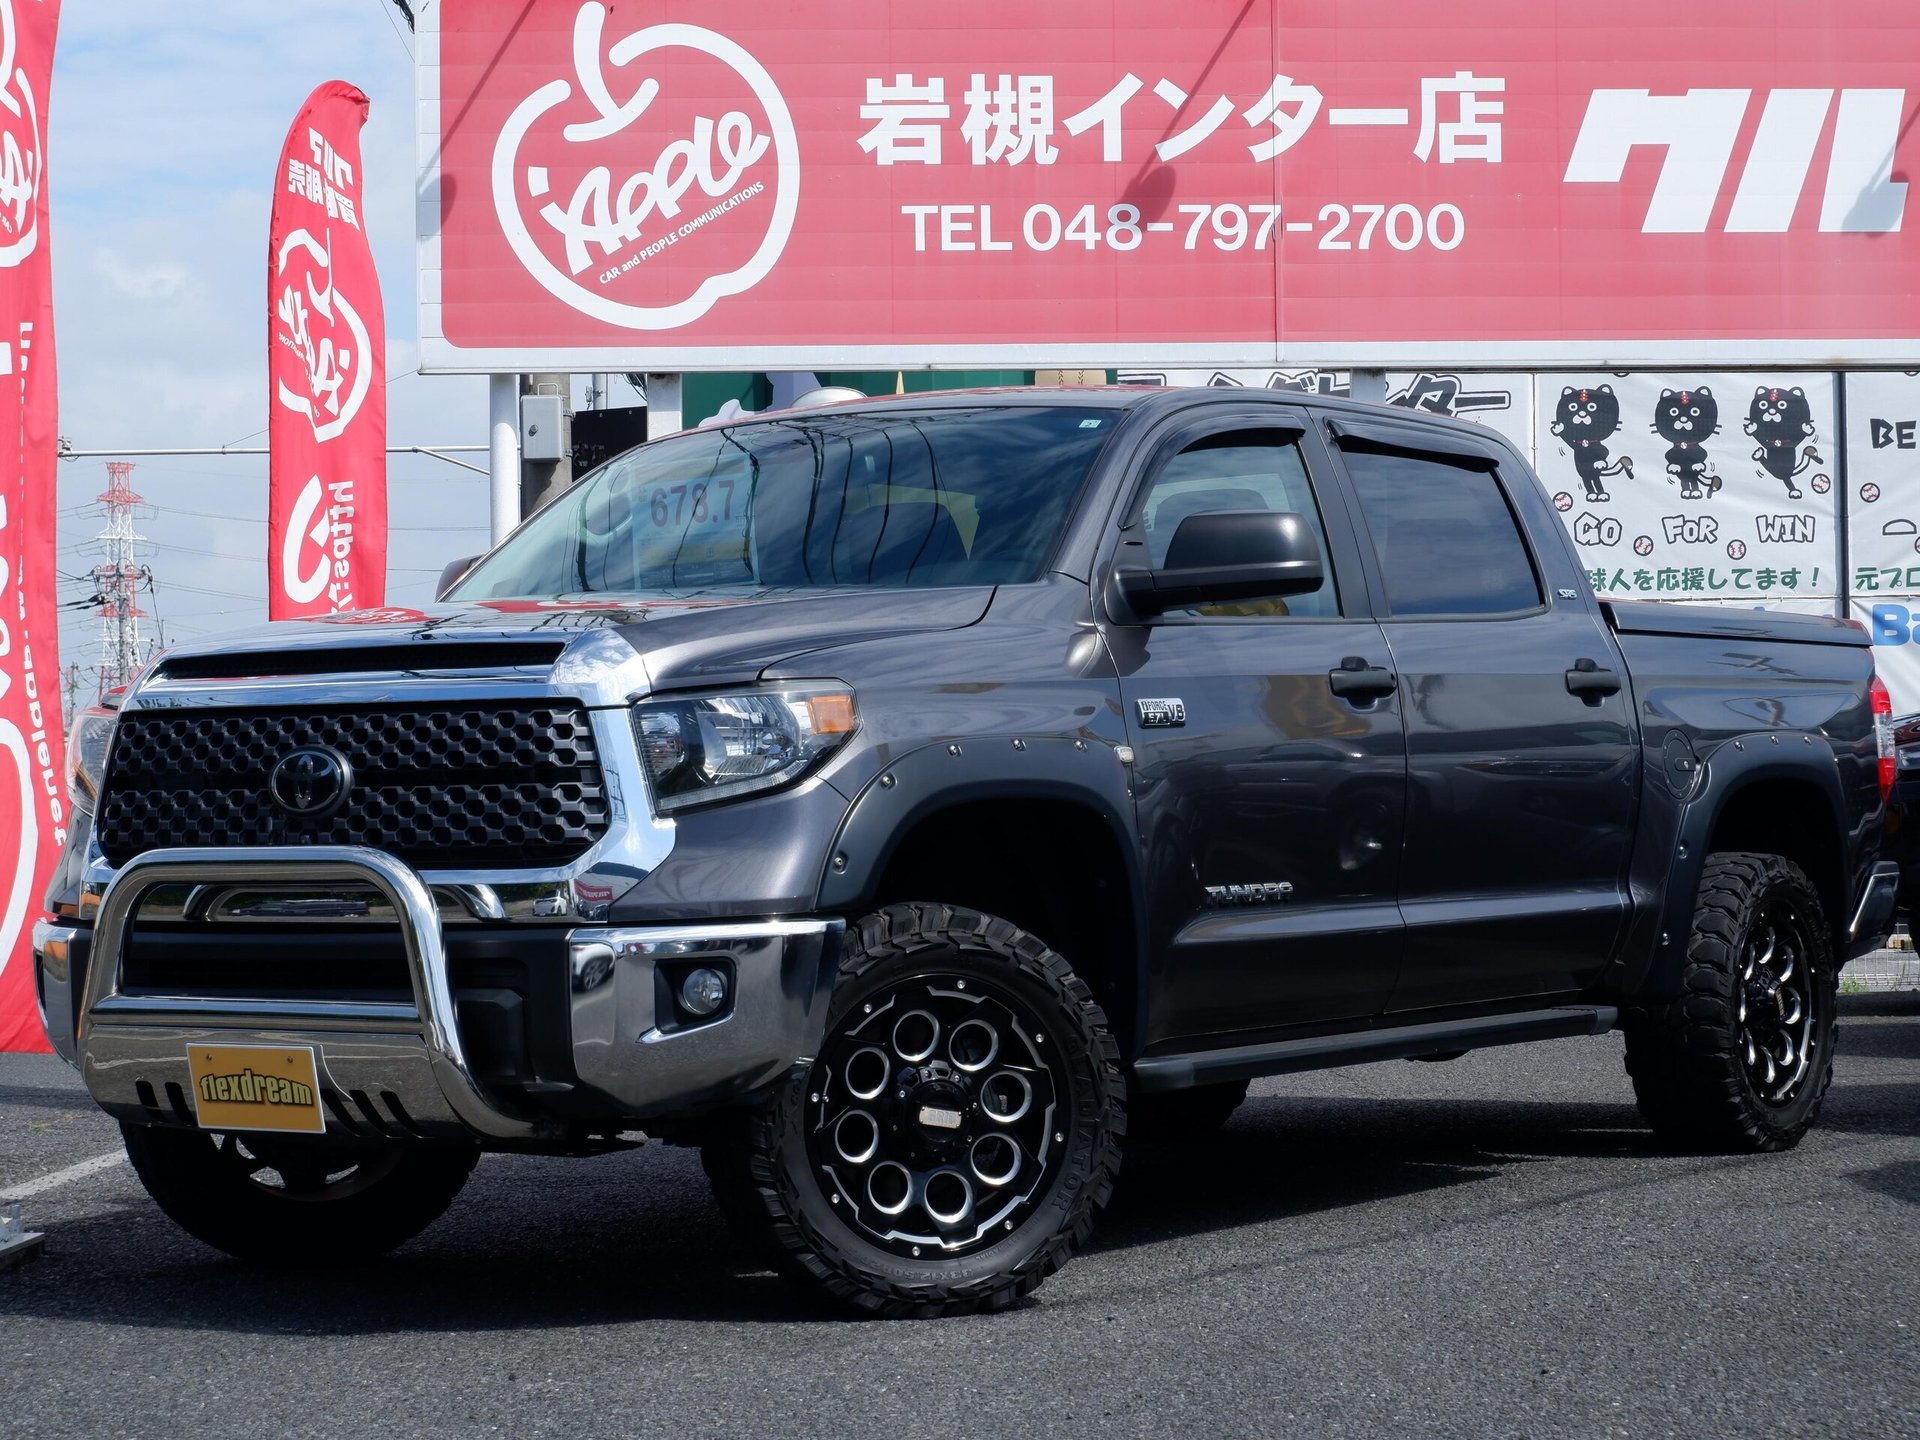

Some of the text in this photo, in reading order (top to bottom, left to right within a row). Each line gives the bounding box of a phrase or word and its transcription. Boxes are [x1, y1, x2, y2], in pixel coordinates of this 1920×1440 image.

[856, 70, 1506, 167] 岩槻インター店
[1563, 88, 1909, 233] クル
[599, 180, 765, 284] CAR and PEOPLE COMMUNICATIONS
[901, 203, 1466, 251] TEL 048-797-2700
[1870, 418, 1917, 450] BE
[650, 479, 736, 528] 678.7
[1573, 511, 1816, 547] GO FOR WIN
[200, 1068, 314, 1107] flexdream
